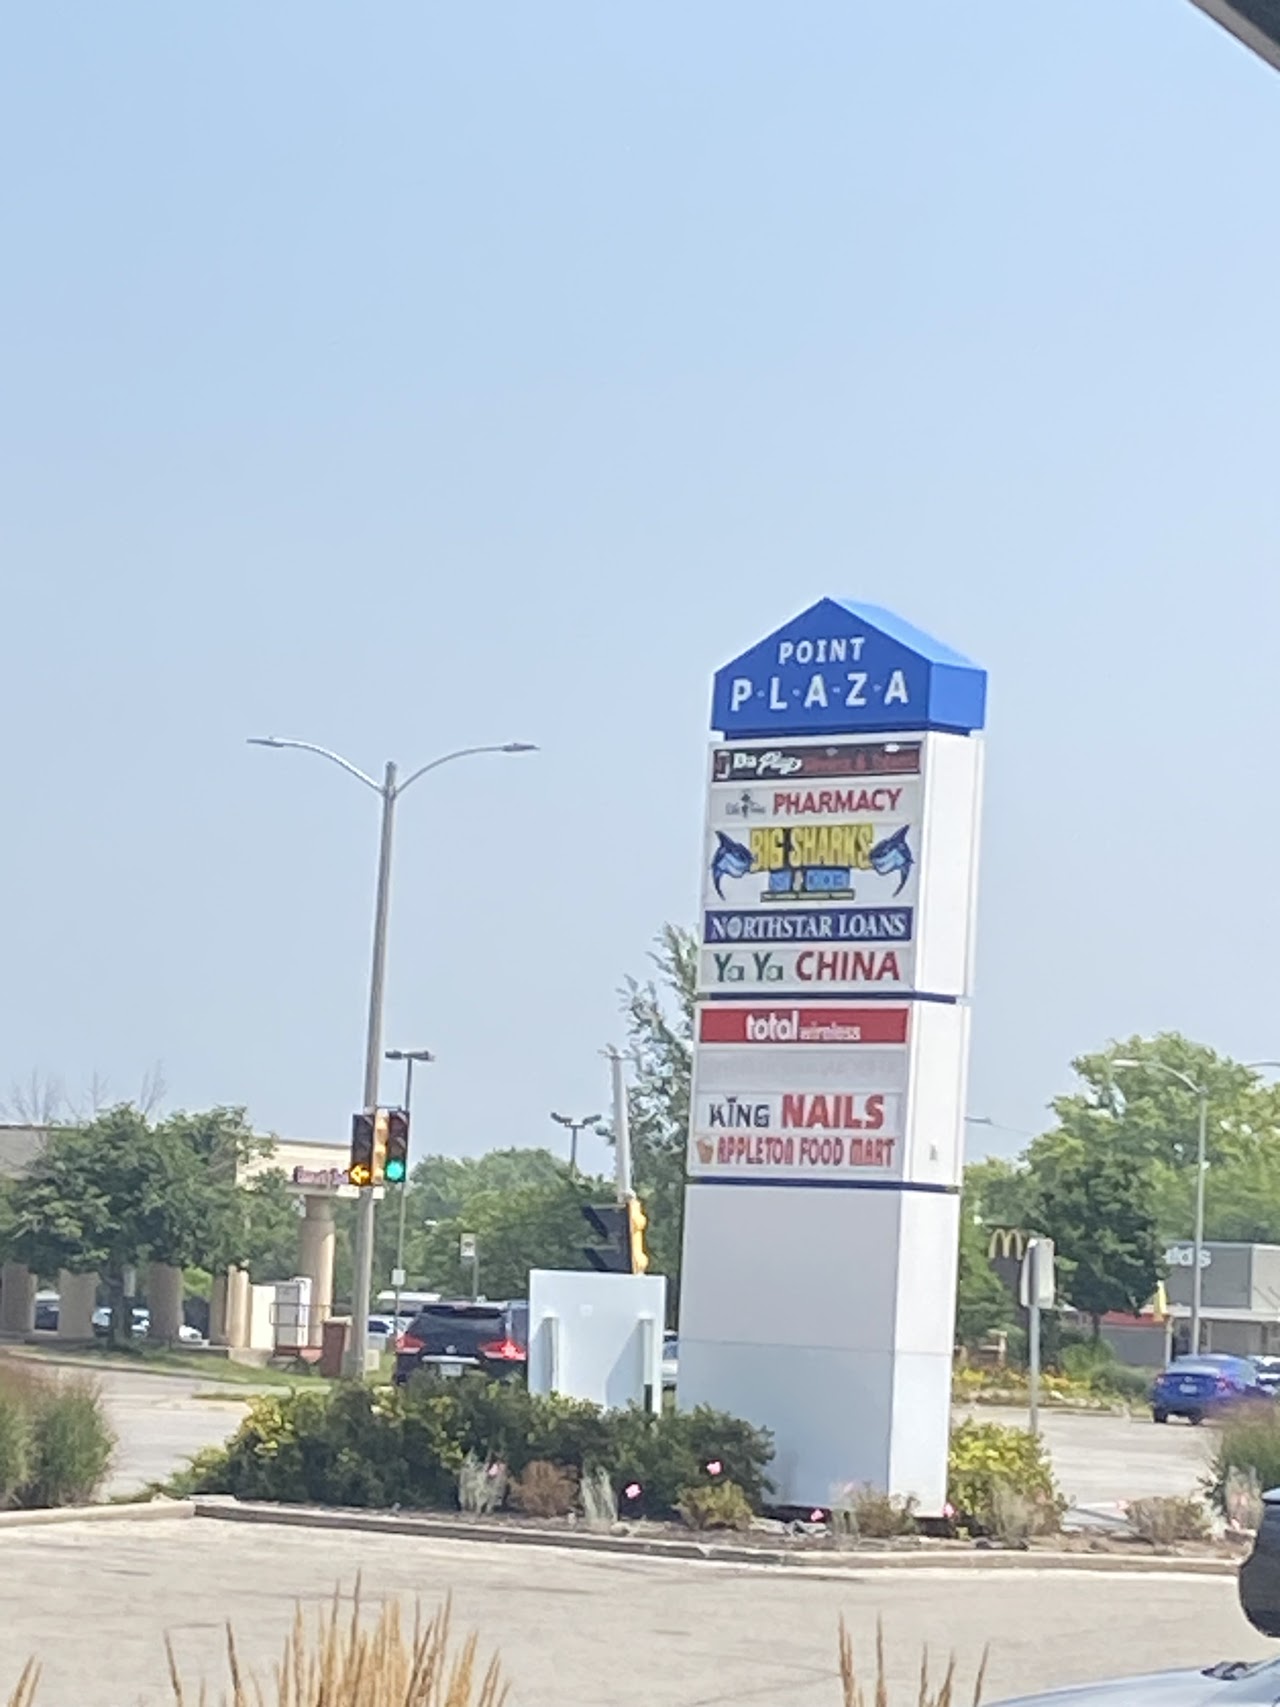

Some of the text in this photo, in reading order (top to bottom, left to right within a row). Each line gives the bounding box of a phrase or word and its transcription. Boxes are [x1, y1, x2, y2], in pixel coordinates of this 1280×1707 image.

[778, 637, 865, 665] POINT
[772, 788, 903, 815] PHARMACY
[751, 824, 874, 873] BIG SHARKS
[711, 913, 906, 939] NORTHSTAR LOANS
[713, 951, 900, 982] Ya Ya CHINA
[745, 1010, 798, 1040] total
[708, 1094, 884, 1129] KING NAILS
[717, 1137, 794, 1165] APPLETON
[799, 1136, 843, 1165] FOOD
